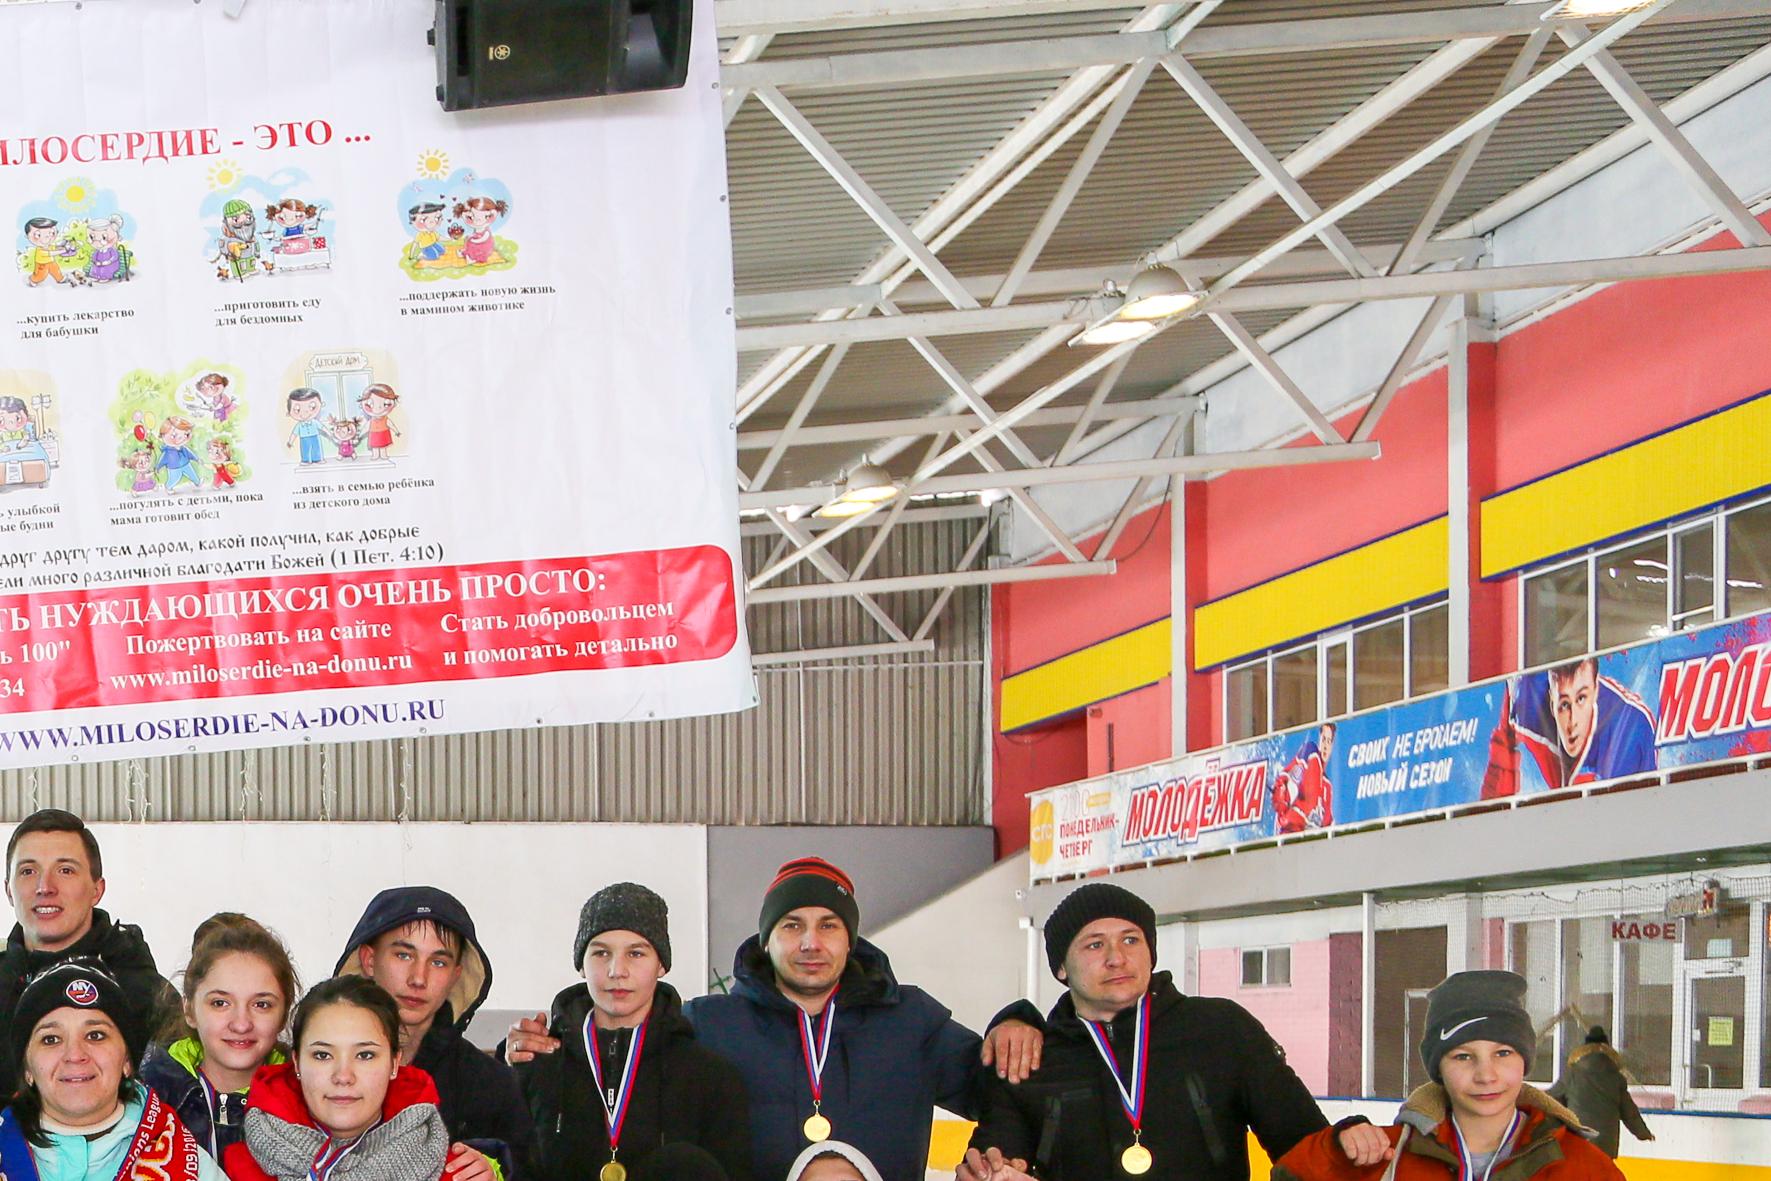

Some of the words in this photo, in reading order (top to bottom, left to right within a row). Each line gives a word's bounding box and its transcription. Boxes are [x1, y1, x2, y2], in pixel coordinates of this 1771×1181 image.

[254, 118, 333, 151] ЭТО
[399, 291, 477, 303] ...поддержать
[481, 285, 518, 298] новую
[520, 283, 556, 295] жизнь
[214, 299, 299, 314] ...приготовить
[302, 296, 322, 308] еду
[401, 307, 408, 316] в
[411, 303, 464, 315] мамином
[467, 300, 525, 313] животике
[17, 314, 70, 327] ...купить
[73, 308, 135, 322] лекарство
[215, 316, 237, 327] для
[240, 312, 304, 327] бездомных
[20, 329, 42, 340] для
[45, 325, 99, 339] бабушки
[292, 484, 335, 495] ...взять
[338, 484, 345, 493] в
[348, 481, 385, 491] семью
[388, 477, 435, 491] ребёнка
[7, 503, 61, 519] улыбкой
[109, 497, 174, 512] ...погулять
[177, 497, 183, 506] с
[186, 493, 233, 507] детьми,
[236, 491, 264, 503] пока
[293, 501, 307, 510] из
[308, 497, 359, 510] детского
[362, 496, 391, 507] дома
[19, 519, 54, 533] будни
[110, 515, 142, 526] мама
[145, 511, 192, 523] готовит
[194, 508, 220, 521] обед
[42, 548, 91, 566] другу
[96, 546, 132, 558] тем
[137, 539, 194, 558] даром,
[198, 532, 246, 551] какой
[250, 531, 321, 550] получил,
[326, 530, 355, 543] как
[358, 525, 420, 544] добрые
[28, 572, 78, 588] много
[83, 563, 172, 587] различной
[270, 553, 325, 571] Божей
[400, 541, 445, 563] 4:10)
[40, 585, 329, 630] НУЖДАЮЩИХСЯ
[338, 578, 452, 610] ОЧЕНЬ
[460, 567, 606, 602] ПРОСТО:
[440, 612, 509, 633] Стать
[514, 602, 674, 632] добровольцем
[126, 626, 290, 656] Пожертвовать
[296, 626, 324, 643] на
[329, 622, 393, 641] сайте
[443, 652, 457, 666] и
[464, 642, 569, 666] помогать
[574, 633, 678, 658] детально
[20, 640, 71, 663] 100"
[110, 654, 413, 690] www.miloserdie-na-donu.ru
[1348, 736, 1390, 768] СВОИХ
[1392, 731, 1413, 759] НЕ
[1357, 761, 1409, 800] НОВЫЙ
[1122, 757, 1269, 847] МОЛОДЁЖКА
[1611, 921, 1677, 941] КАФЕ
